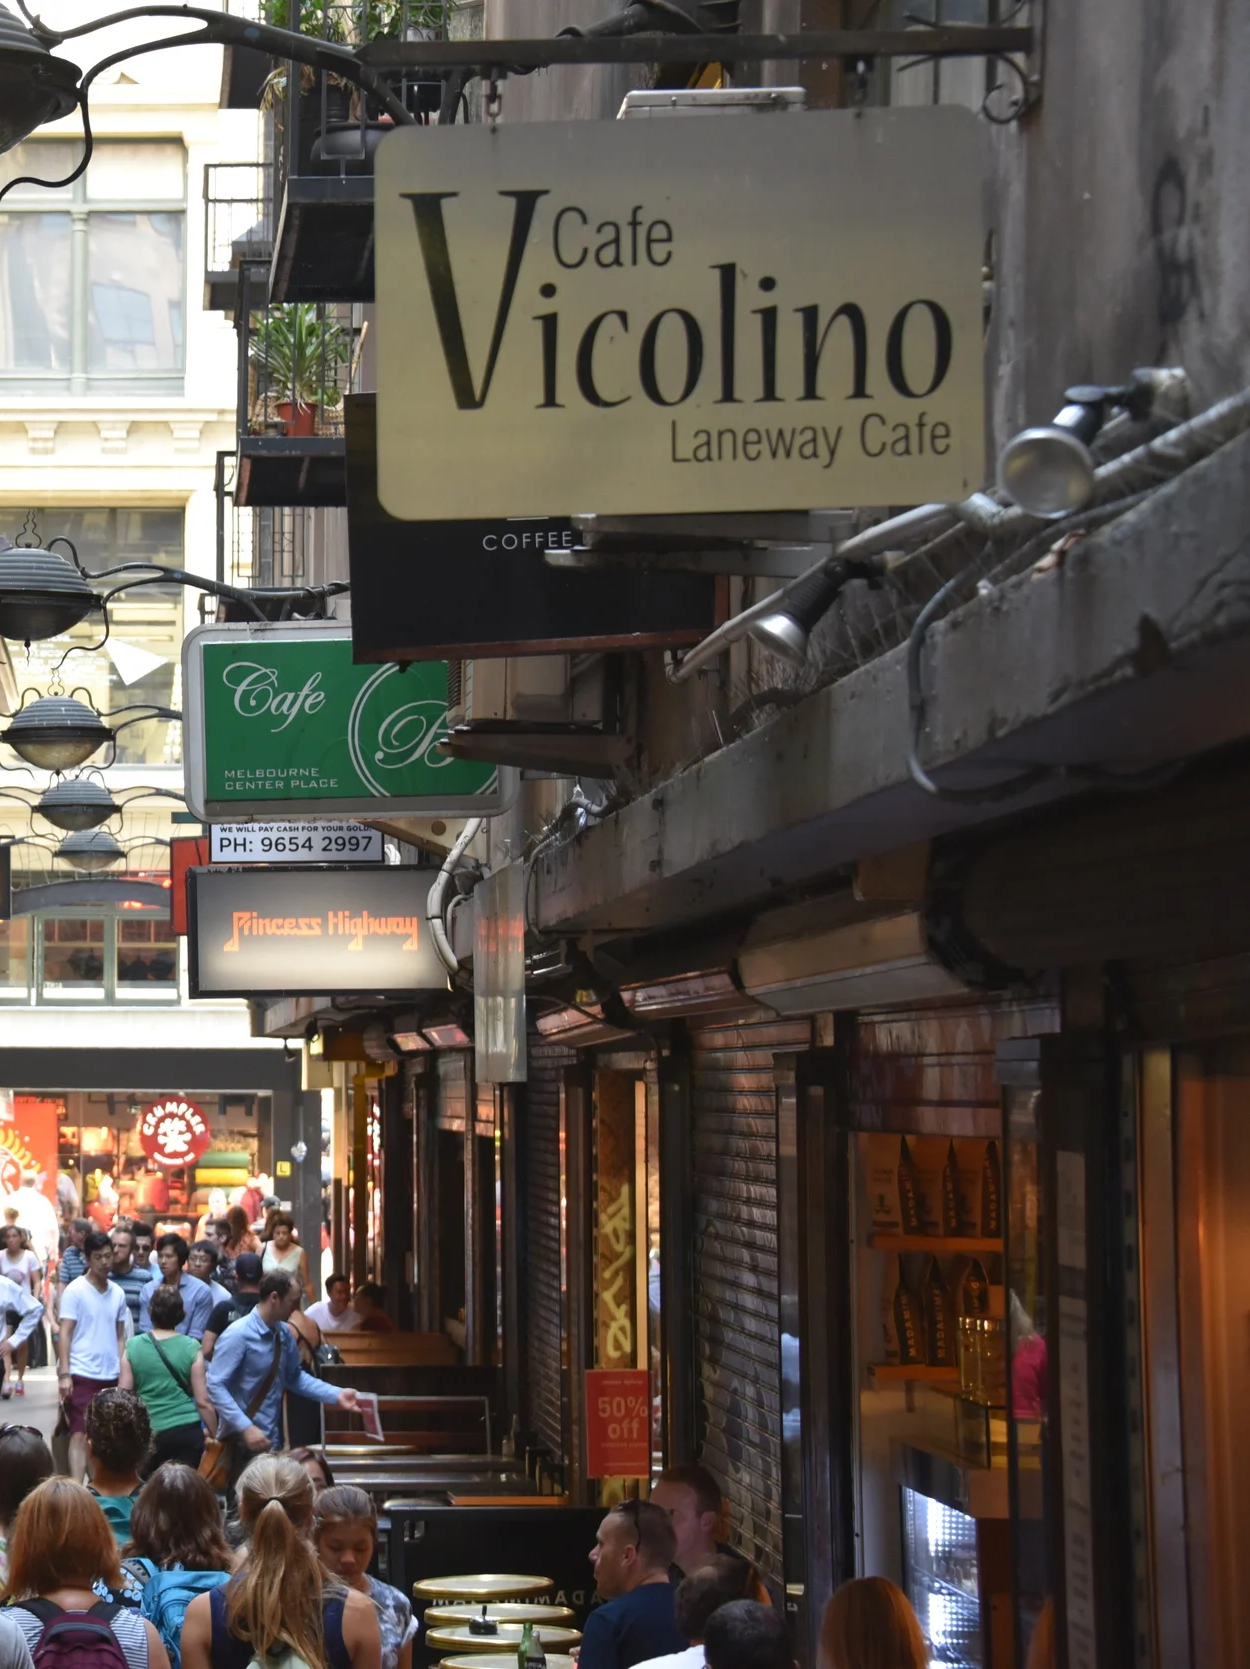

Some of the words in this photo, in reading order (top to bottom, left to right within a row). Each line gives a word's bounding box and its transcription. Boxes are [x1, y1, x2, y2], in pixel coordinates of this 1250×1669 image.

[551, 205, 674, 269] Cafe
[399, 189, 953, 410] Vicolino
[670, 418, 843, 469] Laneway
[859, 411, 951, 458] Cafe
[482, 531, 572, 551] COFFEE
[222, 661, 326, 733] Cafe
[224, 767, 320, 778] MELBOURNE
[225, 779, 285, 791] CENTER
[290, 778, 339, 789] PLACE
[219, 837, 254, 853] PH:
[261, 836, 314, 852] 9654
[321, 835, 373, 852] 2997
[223, 911, 322, 952] Princess
[327, 910, 419, 951] Highway
[598, 1396, 648, 1418] 50%
[607, 1418, 640, 1439] off
